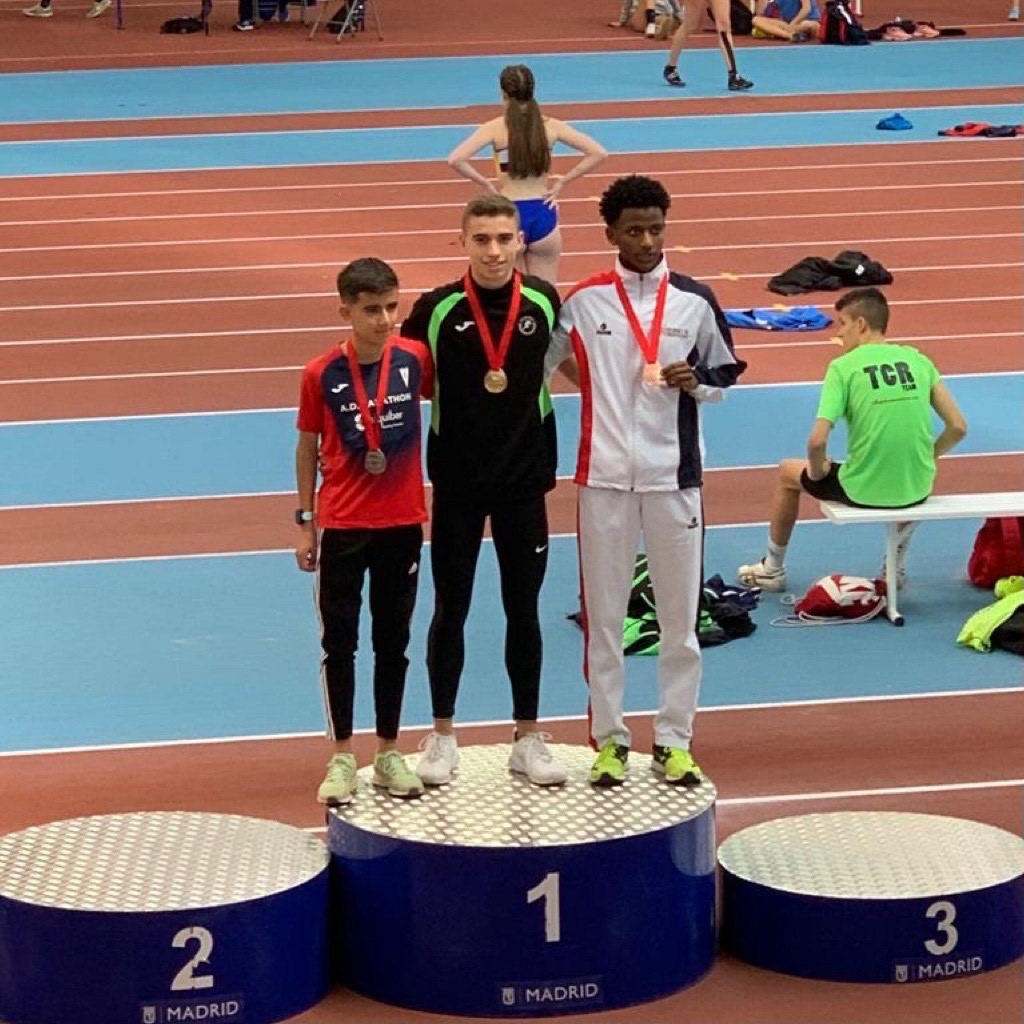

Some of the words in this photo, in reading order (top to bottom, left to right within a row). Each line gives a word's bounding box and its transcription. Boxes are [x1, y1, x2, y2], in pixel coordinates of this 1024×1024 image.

[863, 361, 914, 389] TCR
[527, 872, 560, 942] 1
[924, 901, 959, 955] 3
[170, 926, 214, 991] 2
[918, 957, 983, 980] MADRID
[526, 983, 599, 1003] MADRID
[167, 1001, 239, 1021] MADRID
